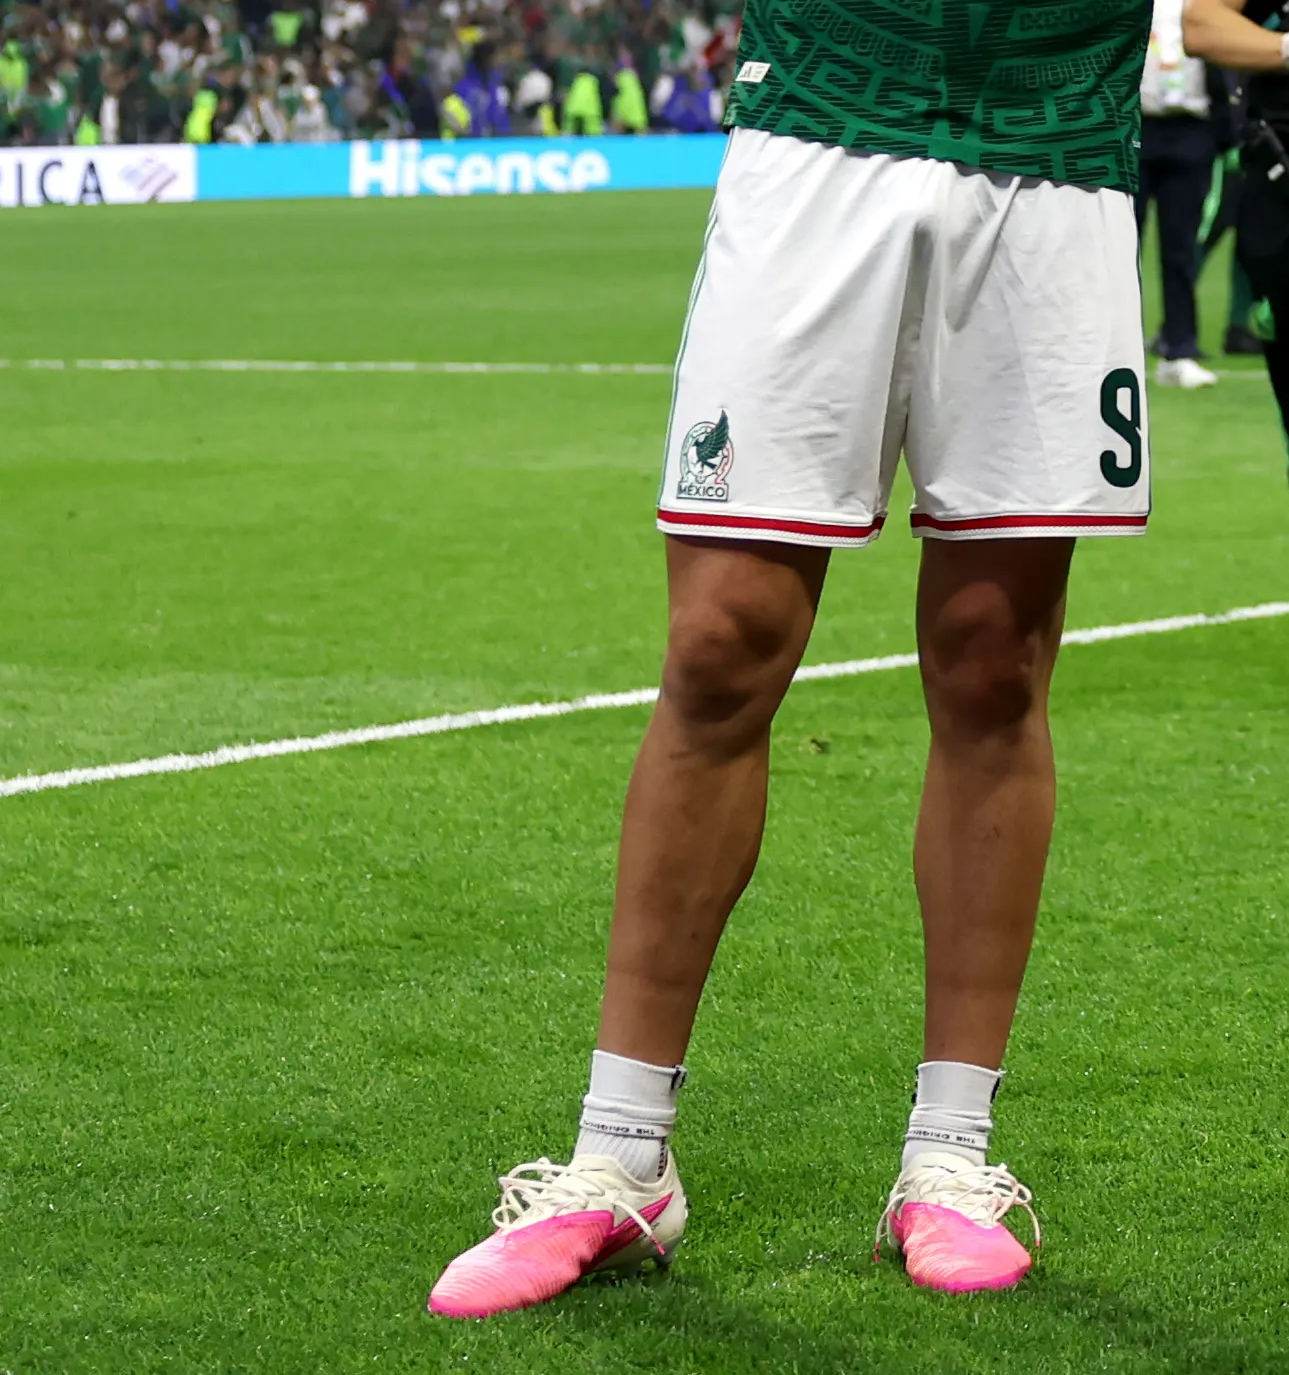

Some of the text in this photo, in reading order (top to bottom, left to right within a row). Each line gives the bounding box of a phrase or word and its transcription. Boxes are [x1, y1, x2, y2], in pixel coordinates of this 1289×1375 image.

[0, 159, 105, 205] ICA
[349, 138, 611, 197] Hisense
[1100, 368, 1143, 488] 9
